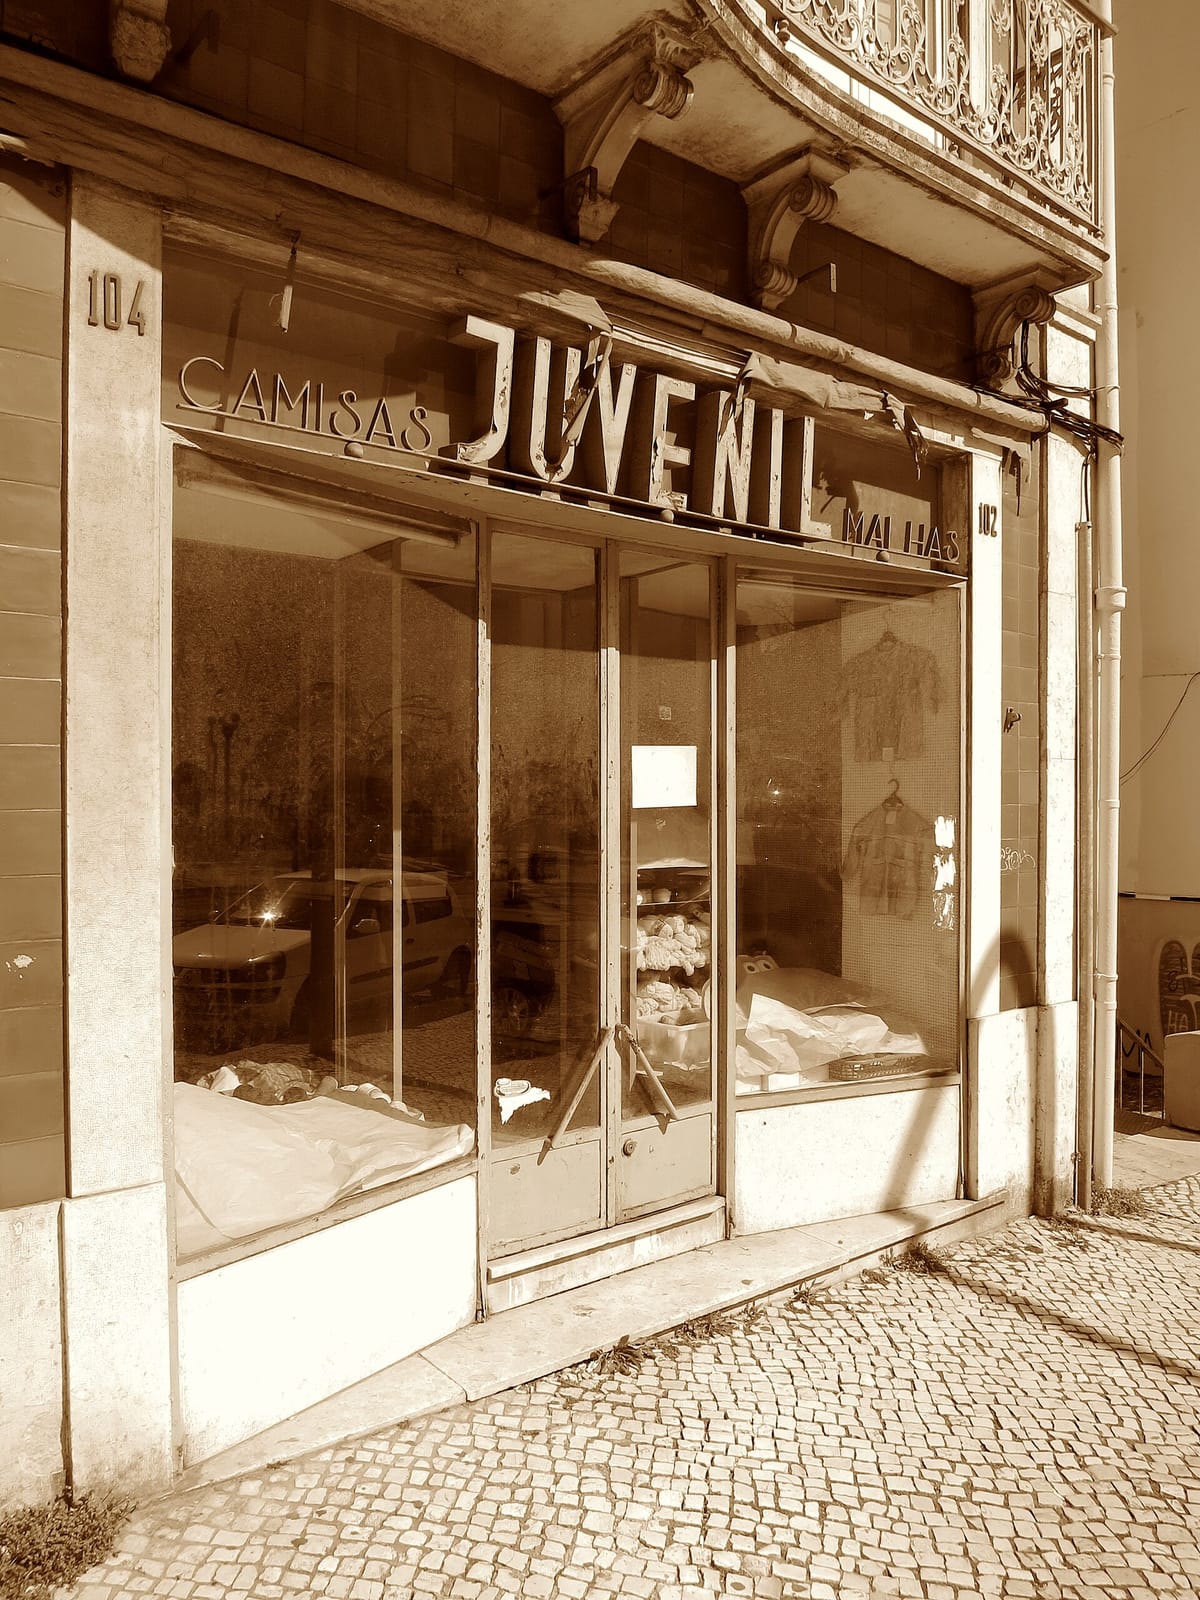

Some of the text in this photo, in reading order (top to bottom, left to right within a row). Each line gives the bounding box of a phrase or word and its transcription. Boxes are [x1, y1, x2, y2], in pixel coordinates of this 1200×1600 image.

[88, 269, 146, 336] 104
[178, 356, 432, 453] CAMISAS
[455, 314, 832, 539] JUVENIL
[842, 507, 960, 563] MALHAS
[978, 502, 998, 538] 102
